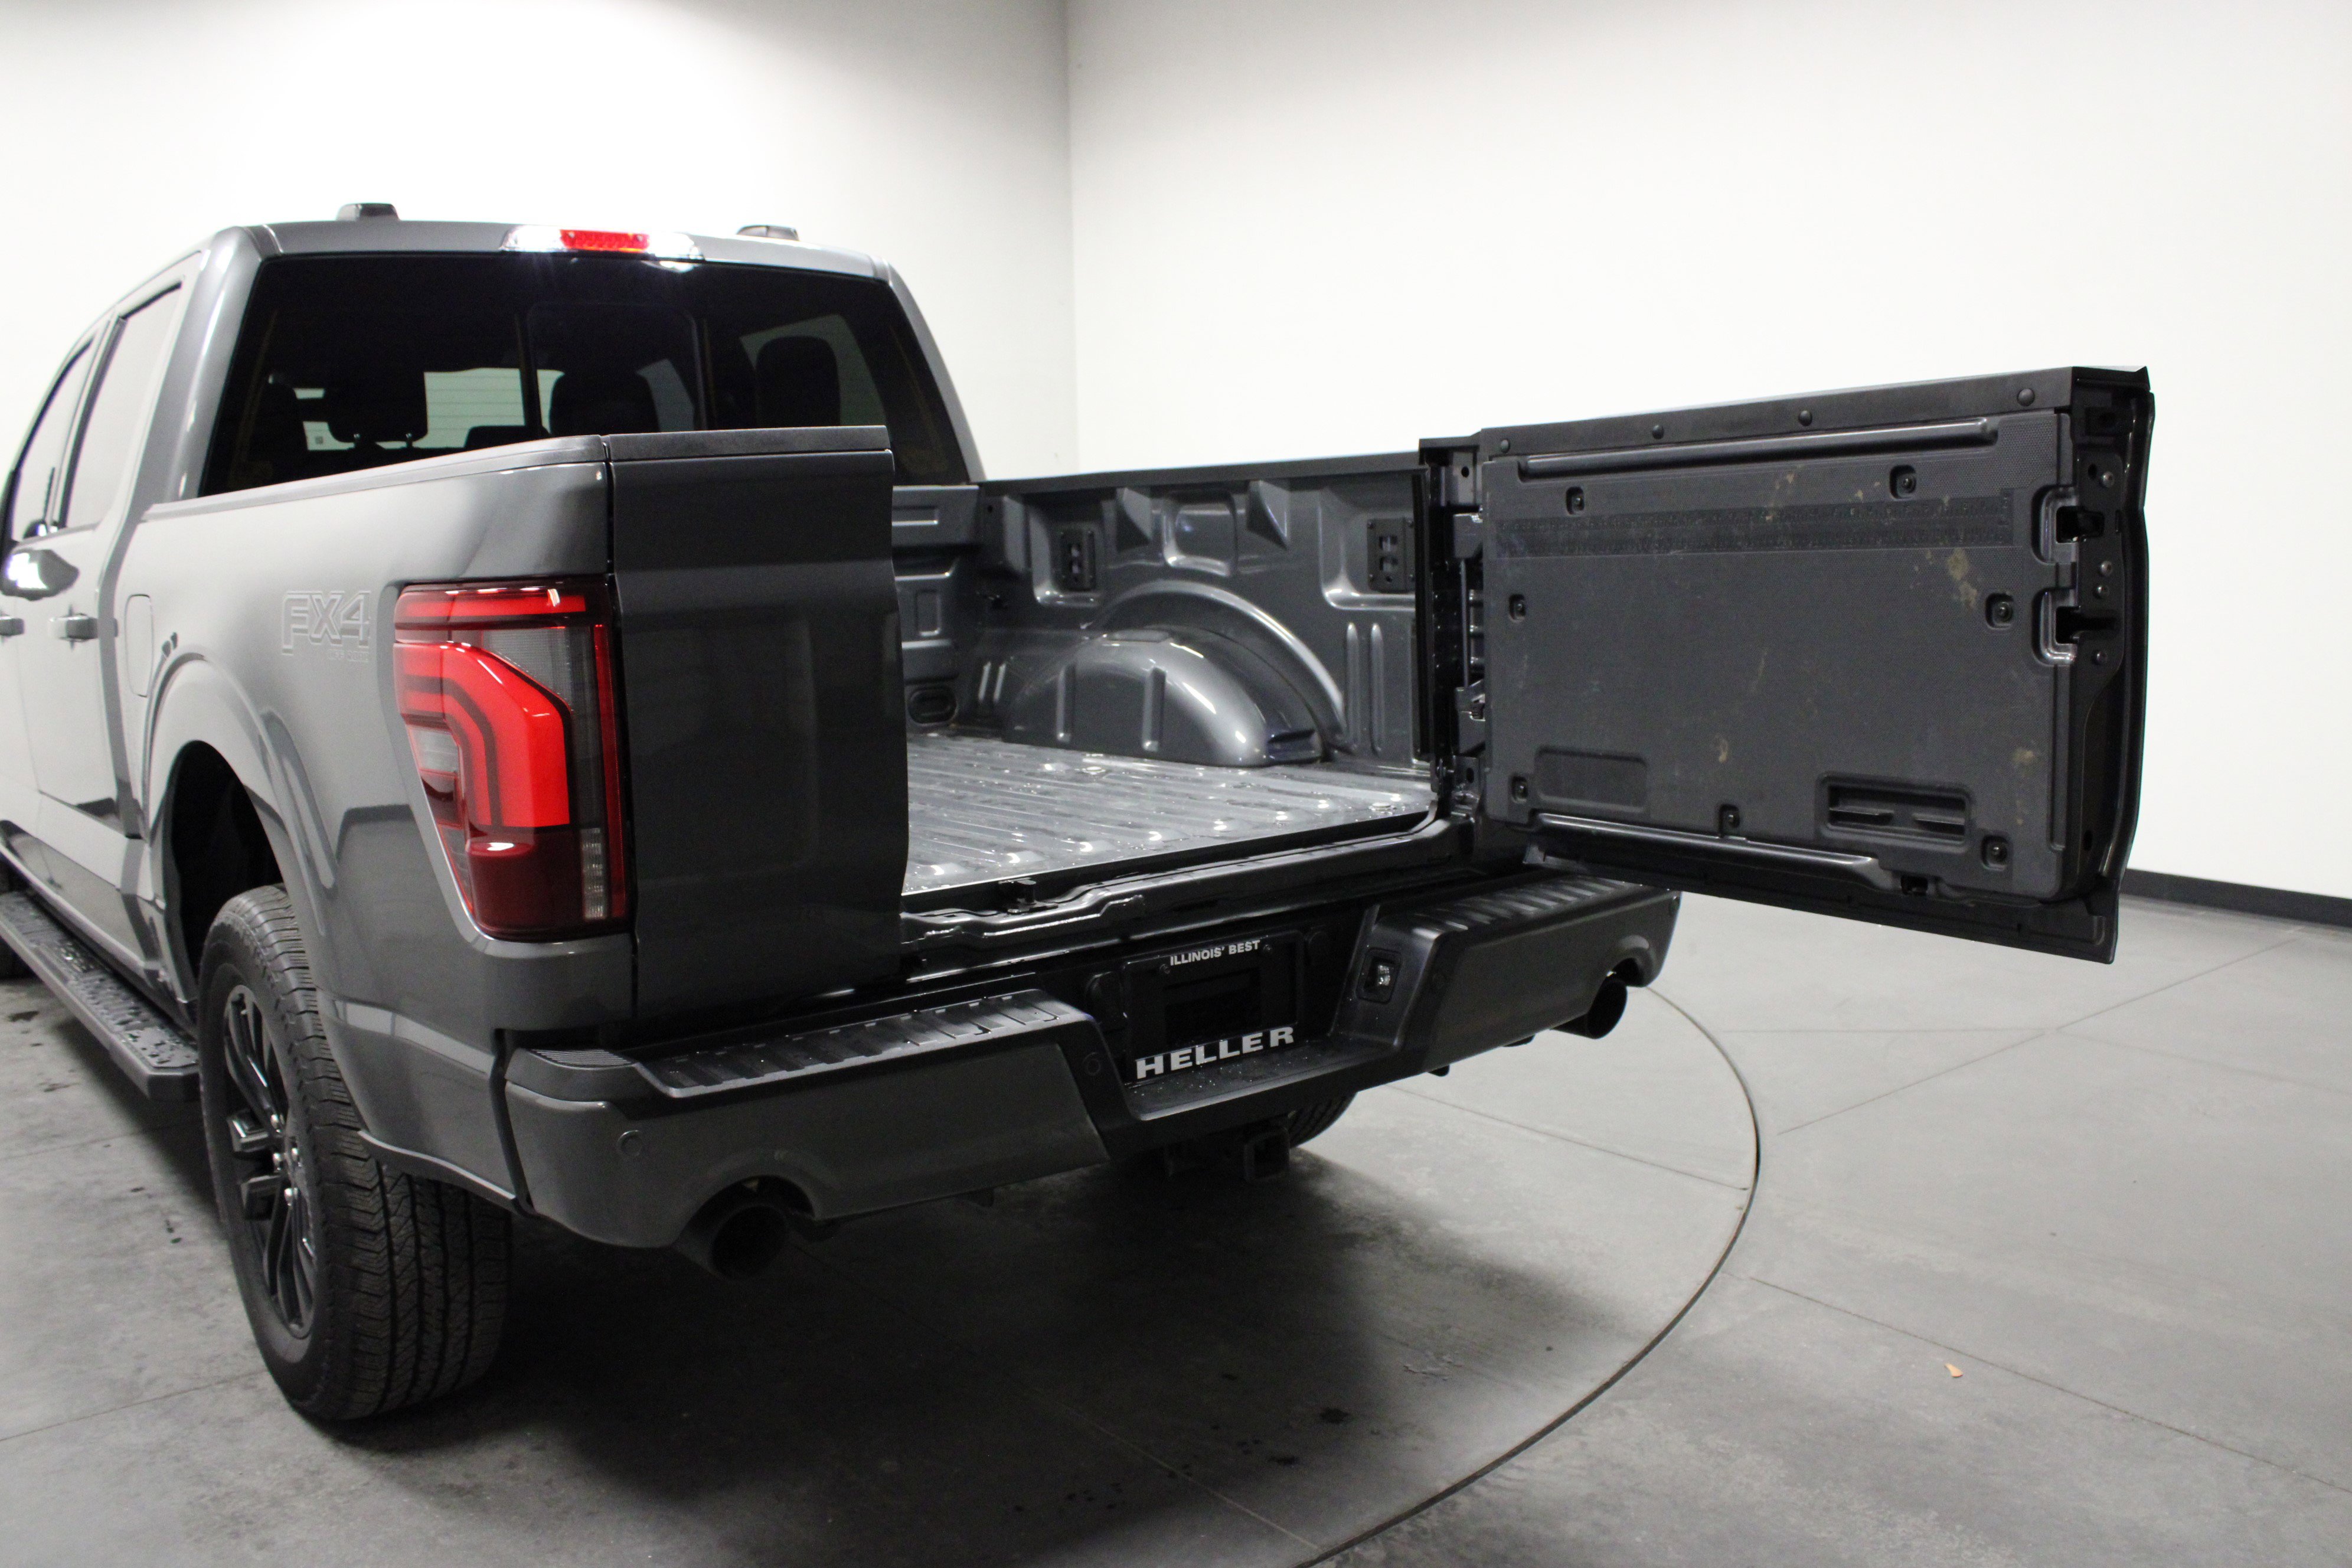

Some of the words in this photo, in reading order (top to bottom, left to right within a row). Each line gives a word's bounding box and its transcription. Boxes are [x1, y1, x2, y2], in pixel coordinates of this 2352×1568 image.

[281, 590, 371, 656] FX4
[1170, 946, 1225, 966] ILLINOIS'
[1228, 939, 1261, 955] BEST
[1136, 1026, 1294, 1080] HELLER
